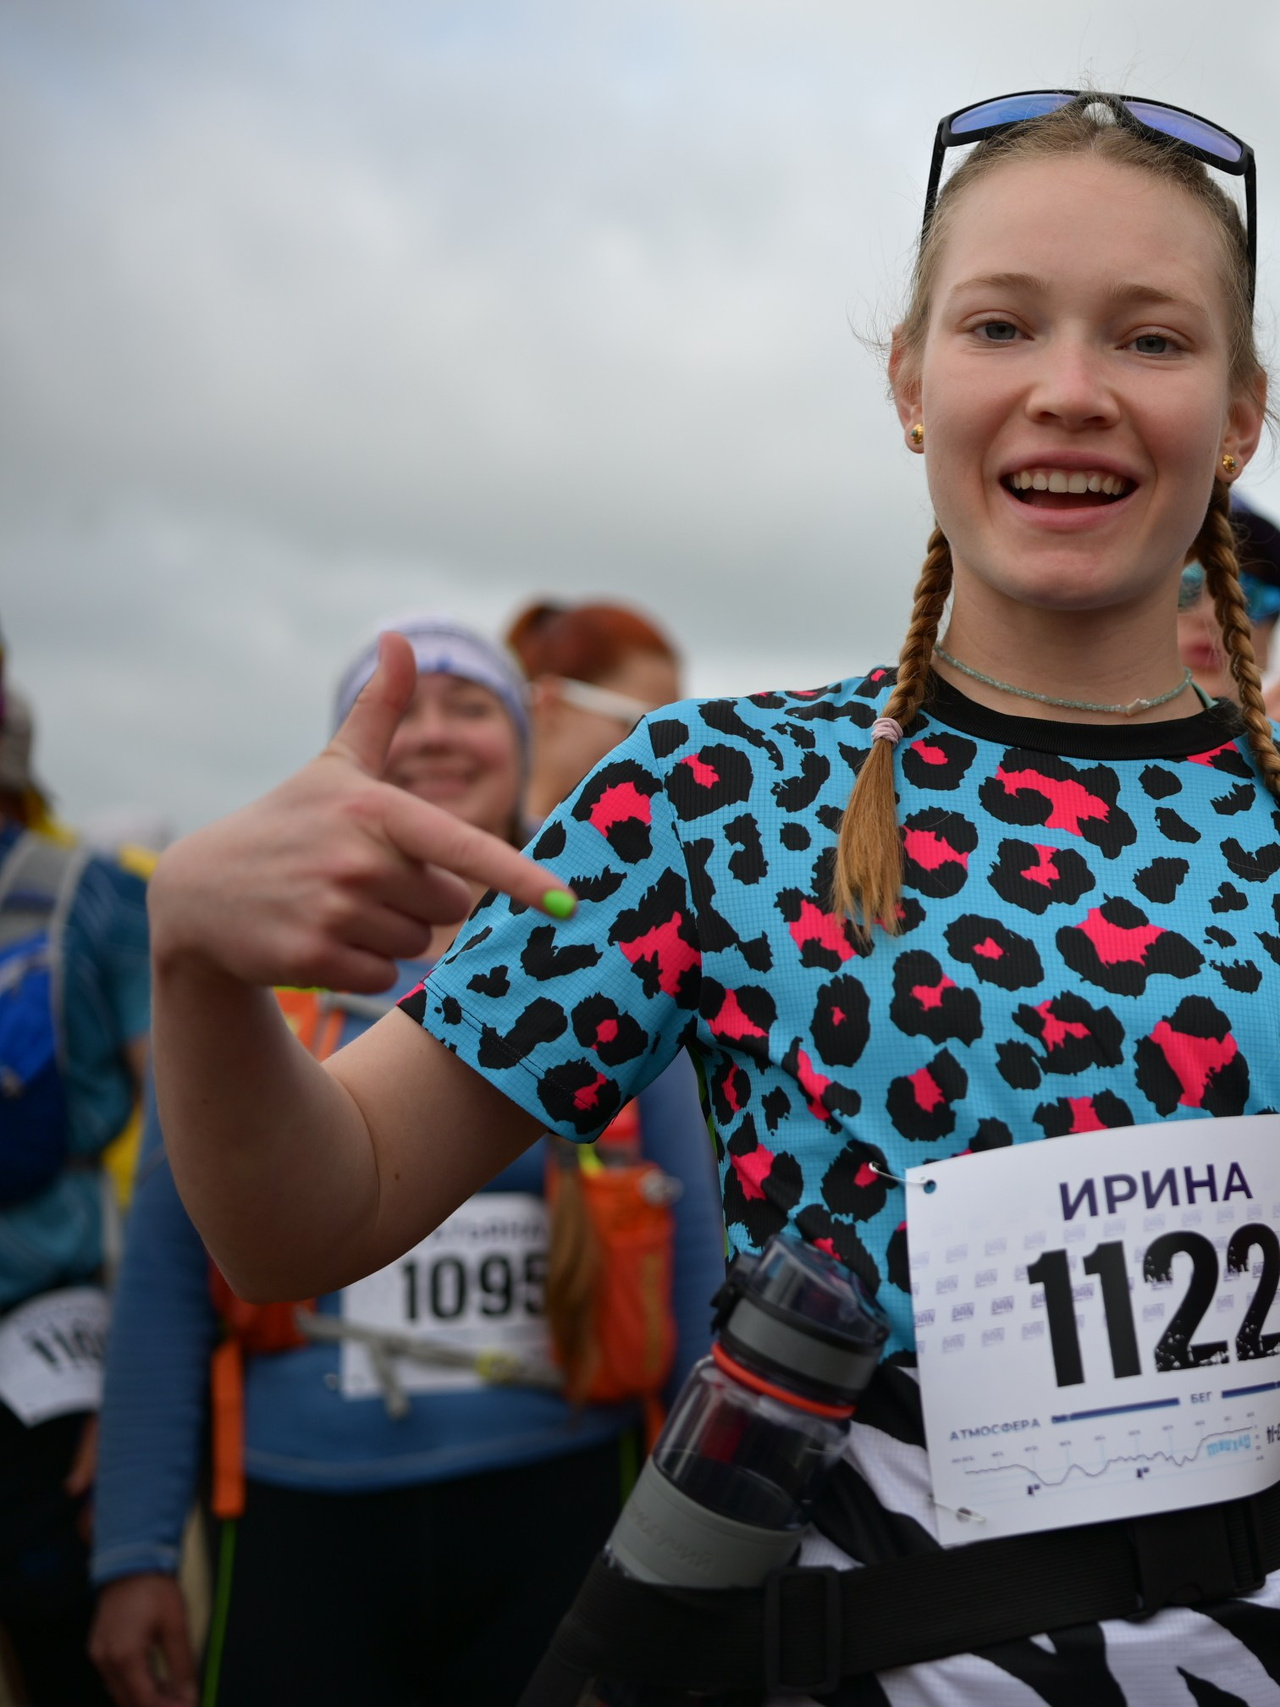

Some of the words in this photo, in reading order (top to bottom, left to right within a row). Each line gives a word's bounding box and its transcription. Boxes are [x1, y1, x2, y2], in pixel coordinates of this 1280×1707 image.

[1059, 1162, 1253, 1221] ИРИНА
[402, 1250, 547, 1326] 1095
[949, 1418, 1042, 1442] АТМОСФЕРА
[1190, 1391, 1213, 1405] БЕГ
